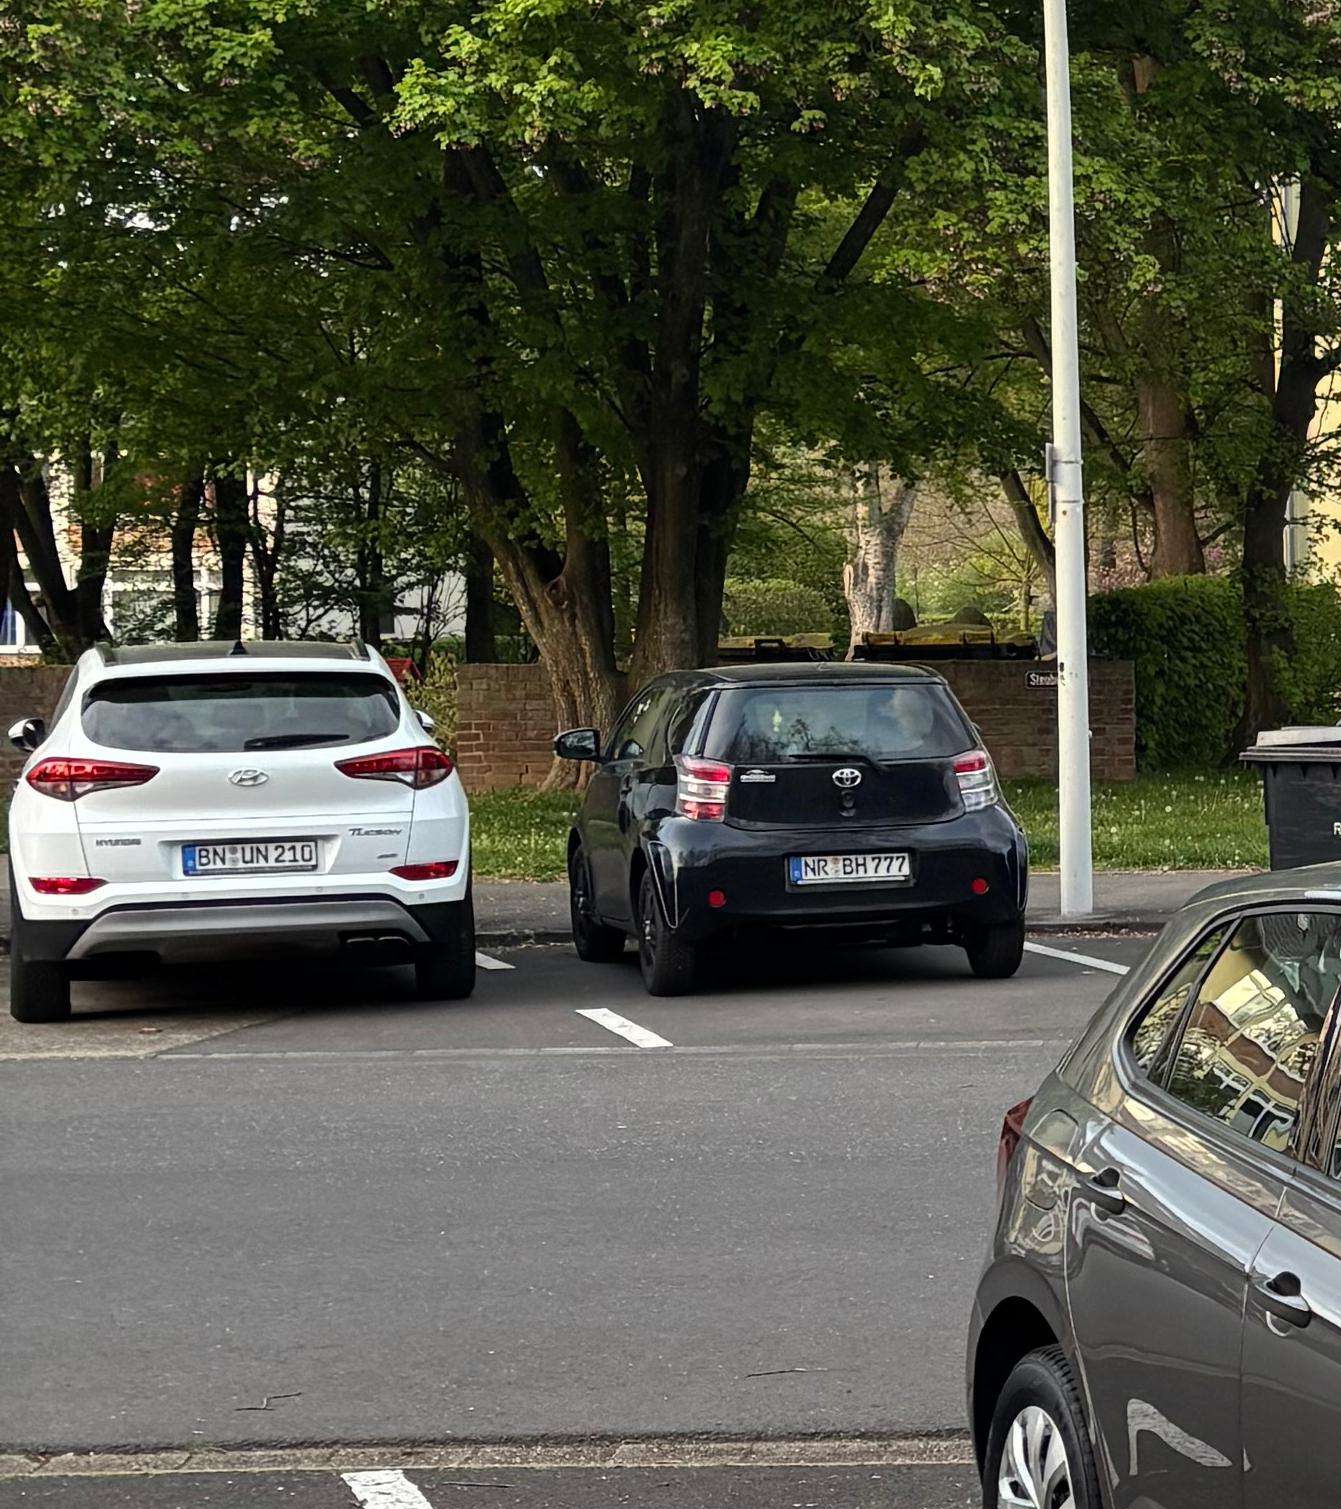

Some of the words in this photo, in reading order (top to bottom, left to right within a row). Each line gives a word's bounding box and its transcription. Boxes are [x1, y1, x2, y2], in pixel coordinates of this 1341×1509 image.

[198, 847, 226, 867] BN
[241, 845, 269, 864] UN
[274, 844, 313, 863] 210
[804, 859, 829, 877] NR
[842, 857, 867, 875] BH
[871, 855, 906, 874] 777
